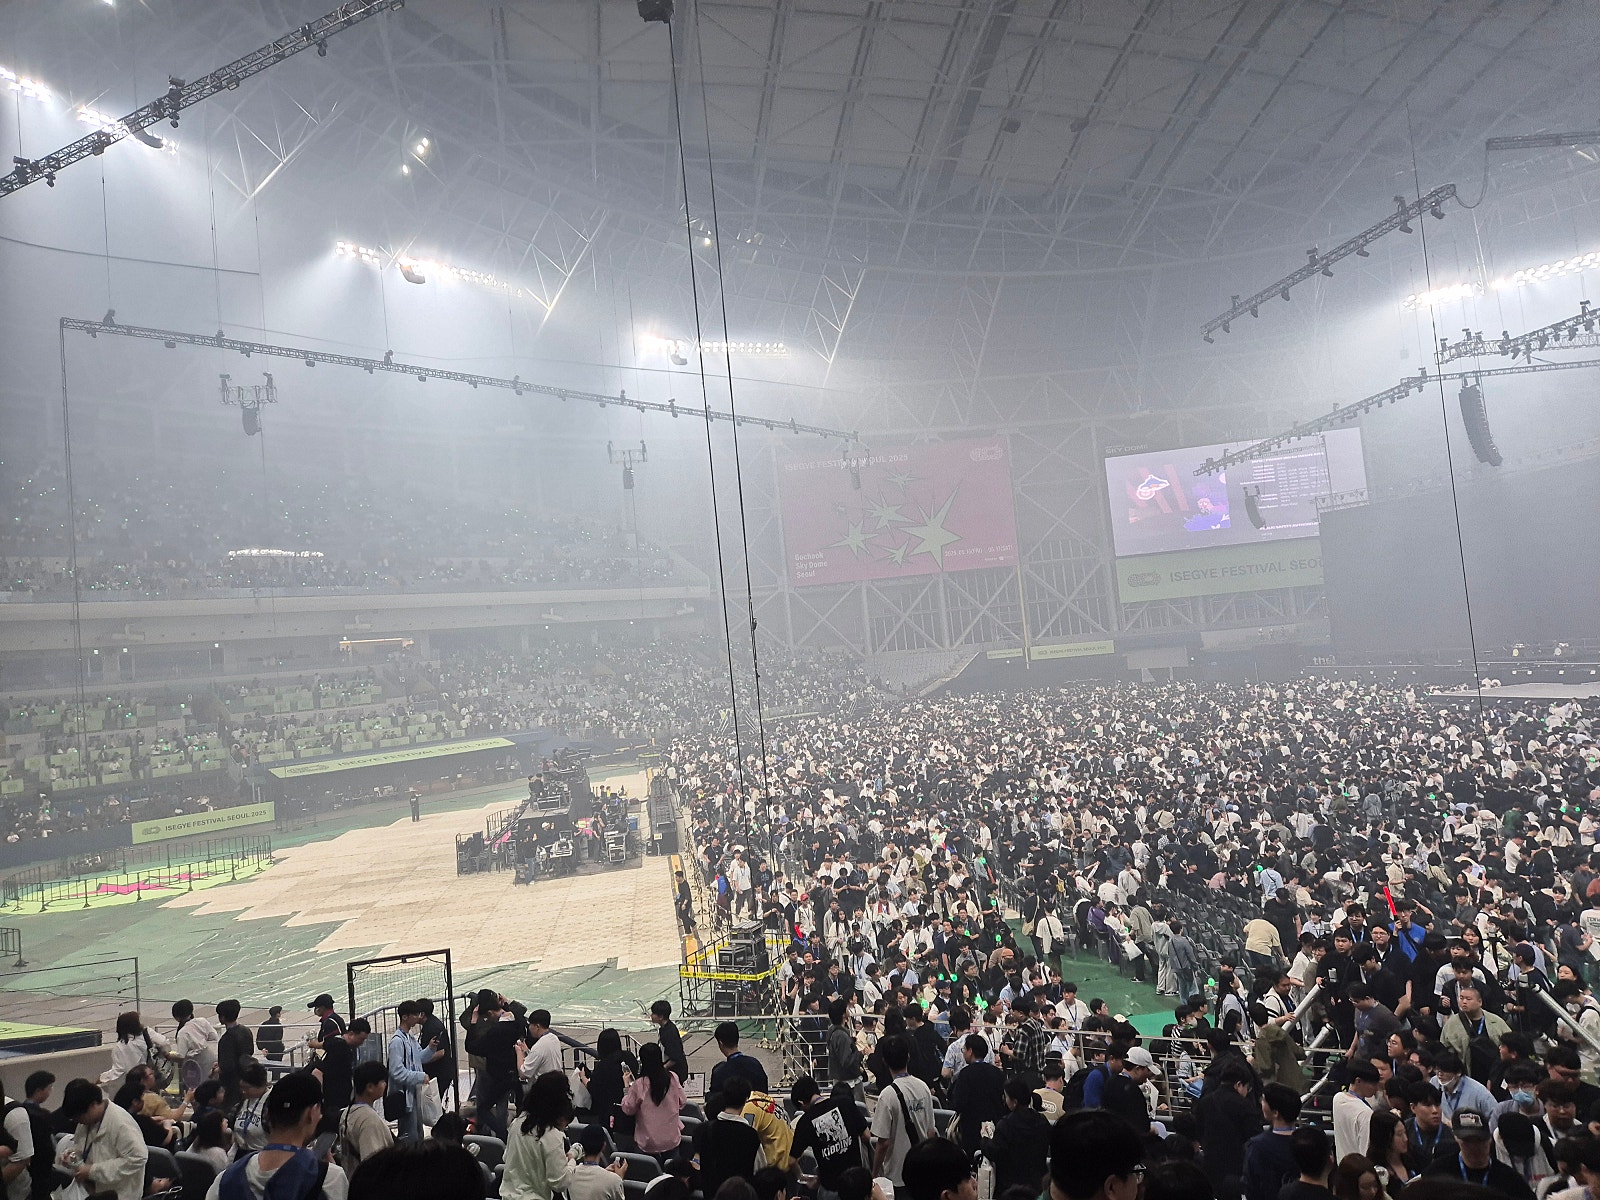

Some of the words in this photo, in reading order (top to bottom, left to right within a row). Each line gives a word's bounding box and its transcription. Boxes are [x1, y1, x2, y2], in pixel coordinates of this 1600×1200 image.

[1170, 568, 1218, 583] ISEGYE
[1220, 562, 1286, 577] FESTIVAL
[337, 758, 378, 767] ISEGYE
[383, 750, 434, 760] FESTIVAL
[165, 822, 192, 832] ISEGYE
[192, 816, 226, 828] FESTIVAL
[228, 812, 250, 821] SEOUL
[251, 809, 267, 818] 2025
